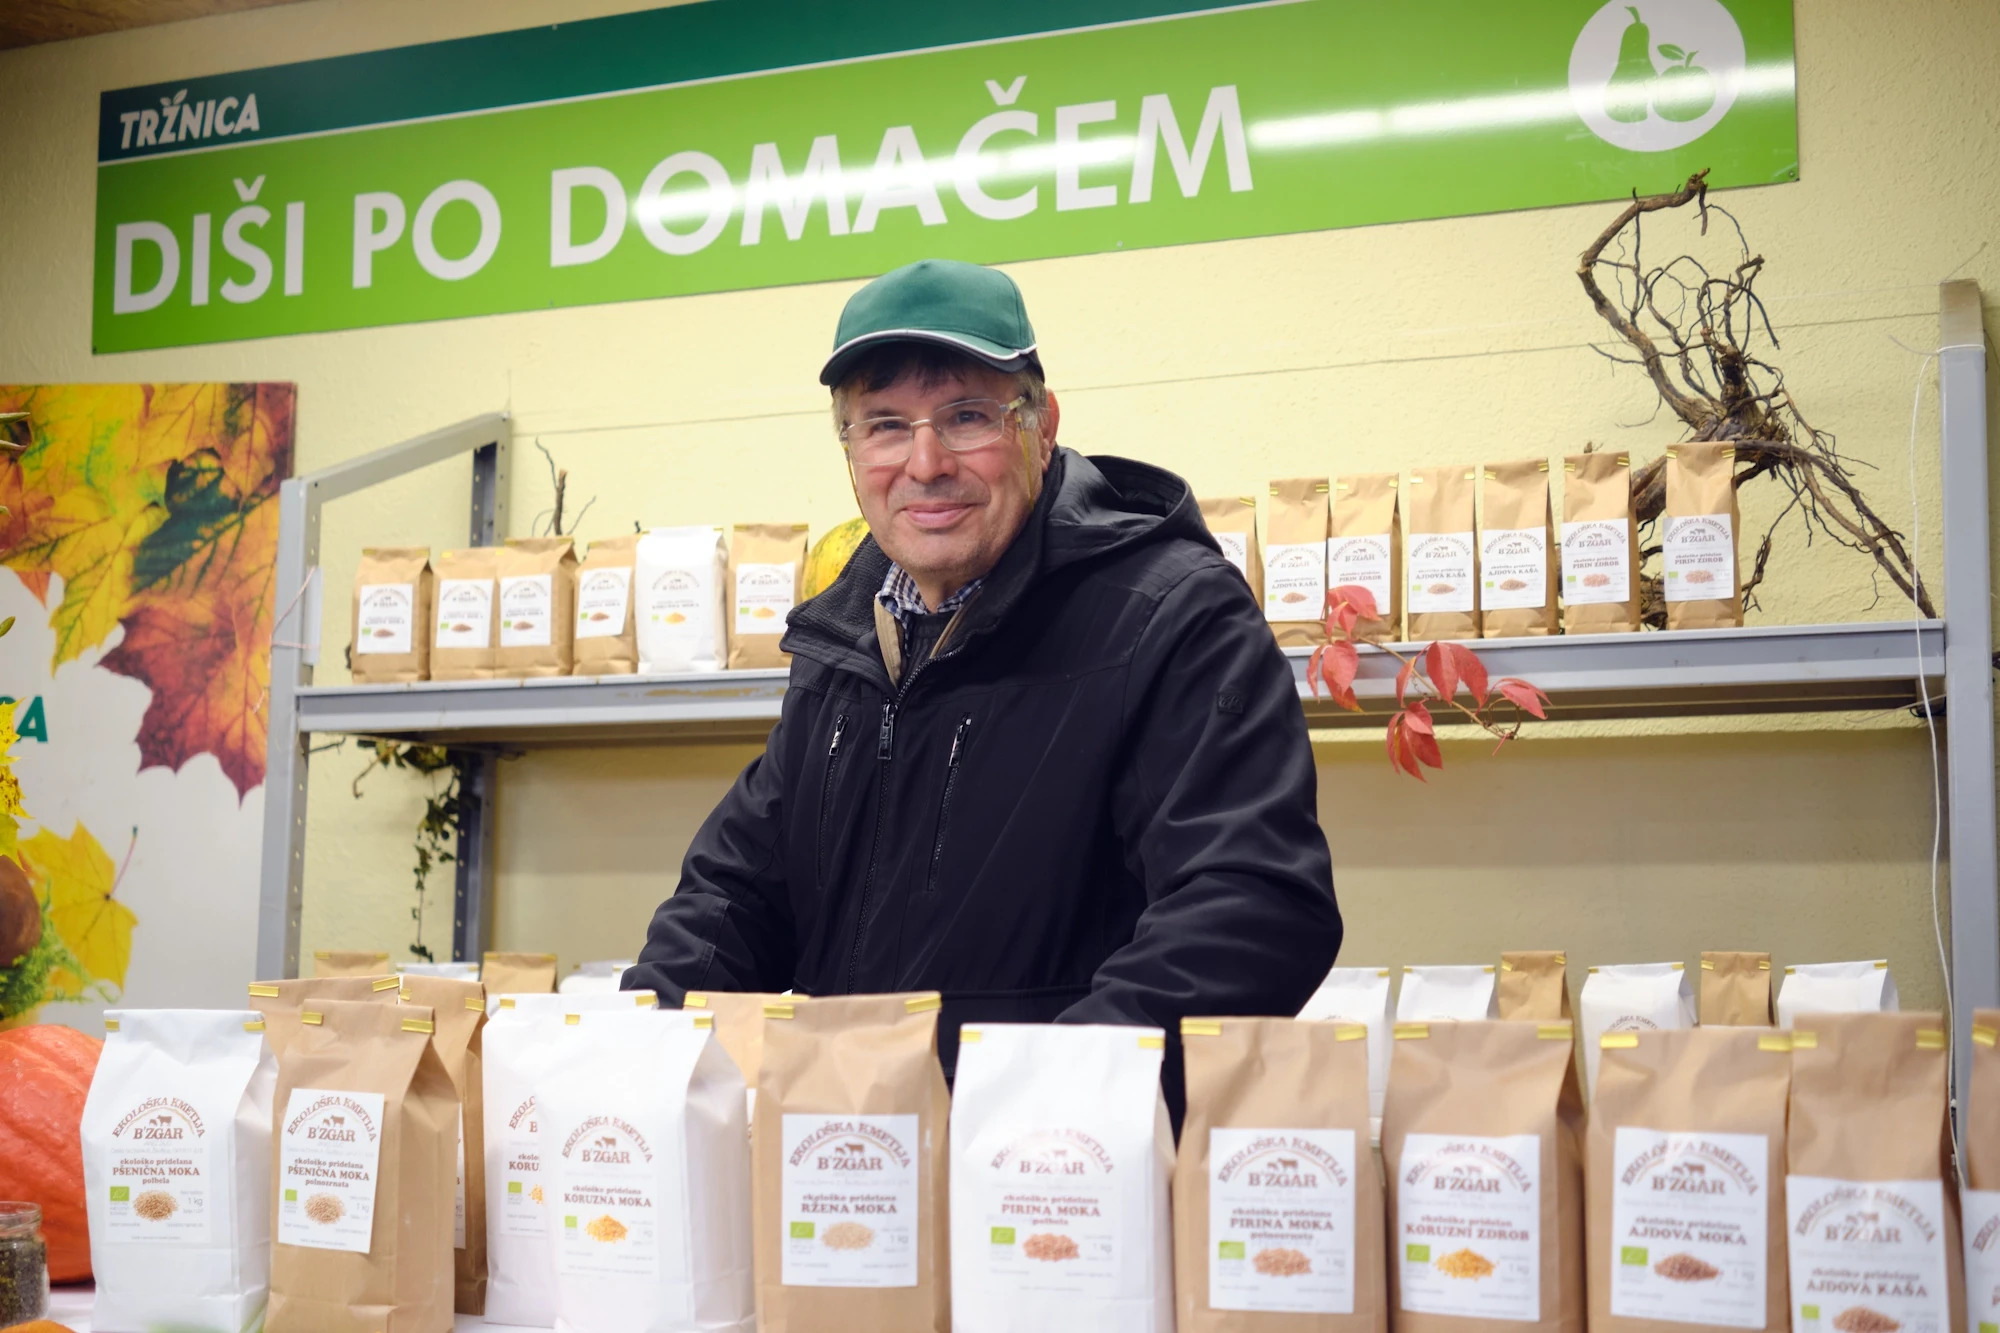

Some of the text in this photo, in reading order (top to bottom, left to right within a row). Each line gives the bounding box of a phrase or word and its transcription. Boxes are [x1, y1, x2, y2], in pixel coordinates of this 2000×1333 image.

[119, 89, 260, 149] TRŽNICA
[112, 75, 1254, 315] DIŠI PO DOMAČEM
[0, 694, 48, 743] A
[112, 1097, 205, 1138] EKOLOŠKA KMETIJA
[287, 1096, 377, 1142] EKOLOŠKA KMETIJA
[509, 1096, 535, 1130] EKOLO
[133, 1127, 183, 1139] B'ZGAR
[307, 1126, 355, 1142] B'ZGAR
[562, 1116, 653, 1163] EKOLOŠKA KMETIJA
[789, 1121, 911, 1169] EKOLOŠKA KMETIJA
[156, 1158, 192, 1166] pridelana
[295, 1158, 363, 1169] ekološko pridelana
[509, 1162, 540, 1171] KORU
[113, 1165, 200, 1176] PŠENIČNA MOKA
[288, 1164, 370, 1181] PŠENIČNA MOKA
[305, 1179, 349, 1188] polnozrnata
[194, 1197, 203, 1206] kg
[564, 1194, 652, 1207] KORUZNA MOKA
[801, 1201, 897, 1213] RŽENA MOKA
[1002, 1204, 1101, 1217] PIRINA MOKA
[1230, 1218, 1333, 1231] PIRINA MOKA
[1405, 1223, 1530, 1241] KORUZNI ZDROB
[1629, 1227, 1747, 1246] AJDOVA MOKA
[1806, 1279, 1928, 1298] AJDOVA KAŠA
